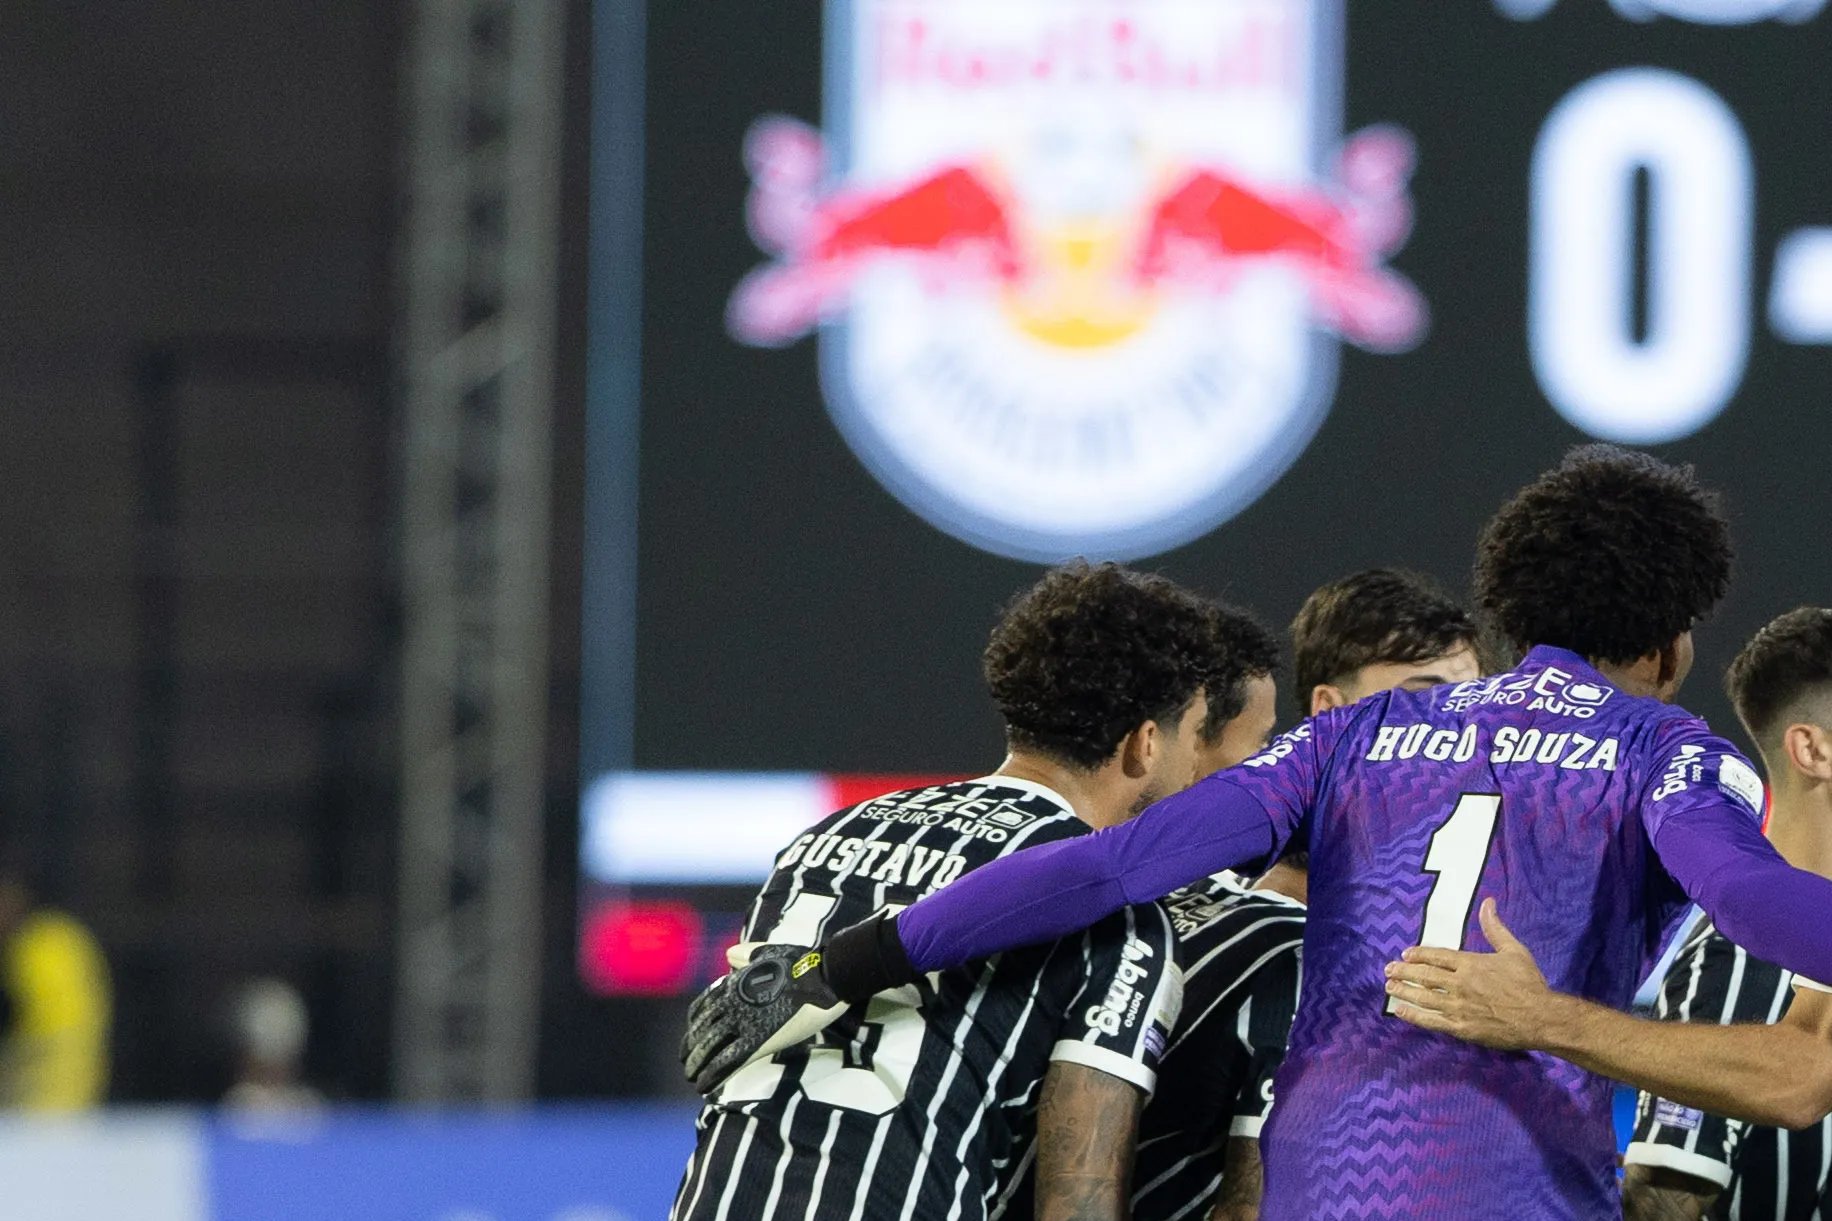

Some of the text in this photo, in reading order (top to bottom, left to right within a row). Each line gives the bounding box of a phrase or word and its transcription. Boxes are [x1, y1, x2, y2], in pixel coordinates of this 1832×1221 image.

[1526, 696, 1596, 719] AUTO
[1365, 723, 1620, 772] HUGO SOUZA
[860, 804, 1008, 844] SEGURO AUTO
[777, 833, 968, 890] GUSTAVO
[1382, 792, 1503, 1016] 1
[1123, 990, 1146, 1029] banco
